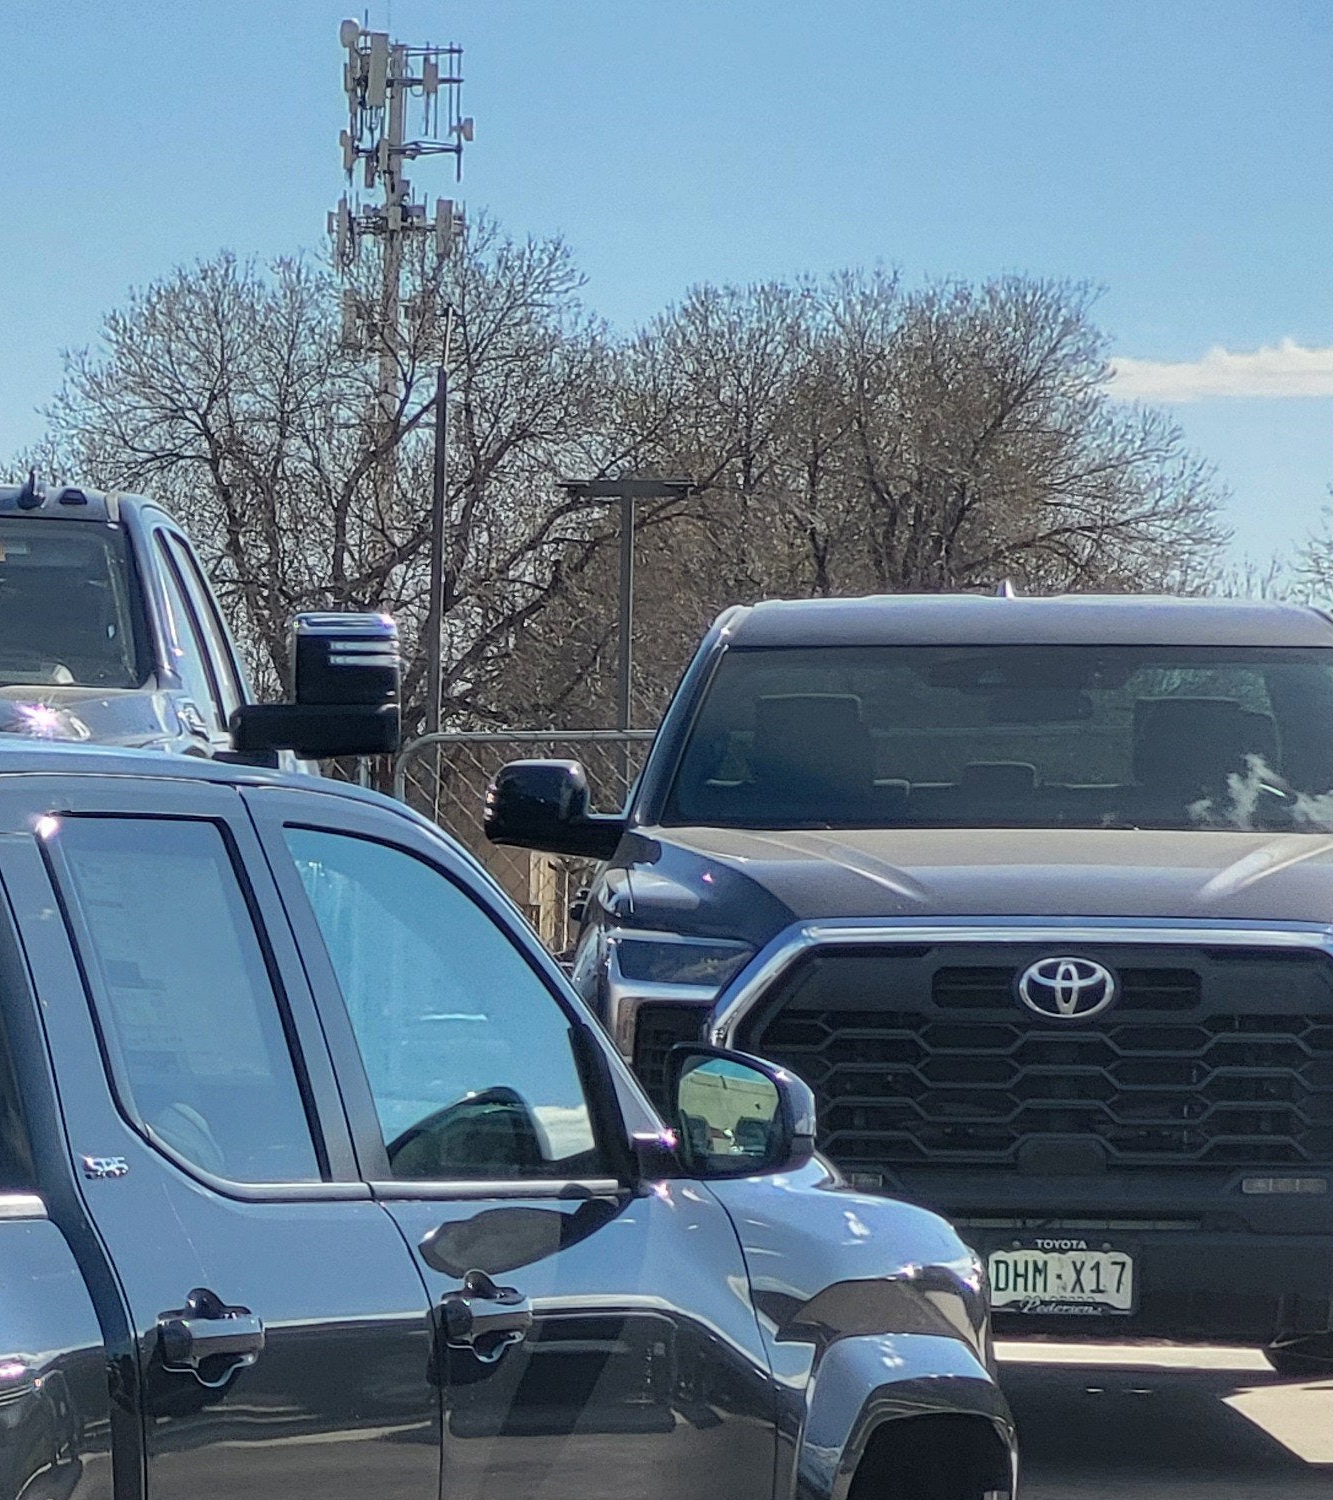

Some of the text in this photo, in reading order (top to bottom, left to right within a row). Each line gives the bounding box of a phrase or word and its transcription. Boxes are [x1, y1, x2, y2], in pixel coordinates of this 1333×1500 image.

[1036, 1239, 1087, 1249] TOYOTA
[994, 1260, 1126, 1293] DHM X17
